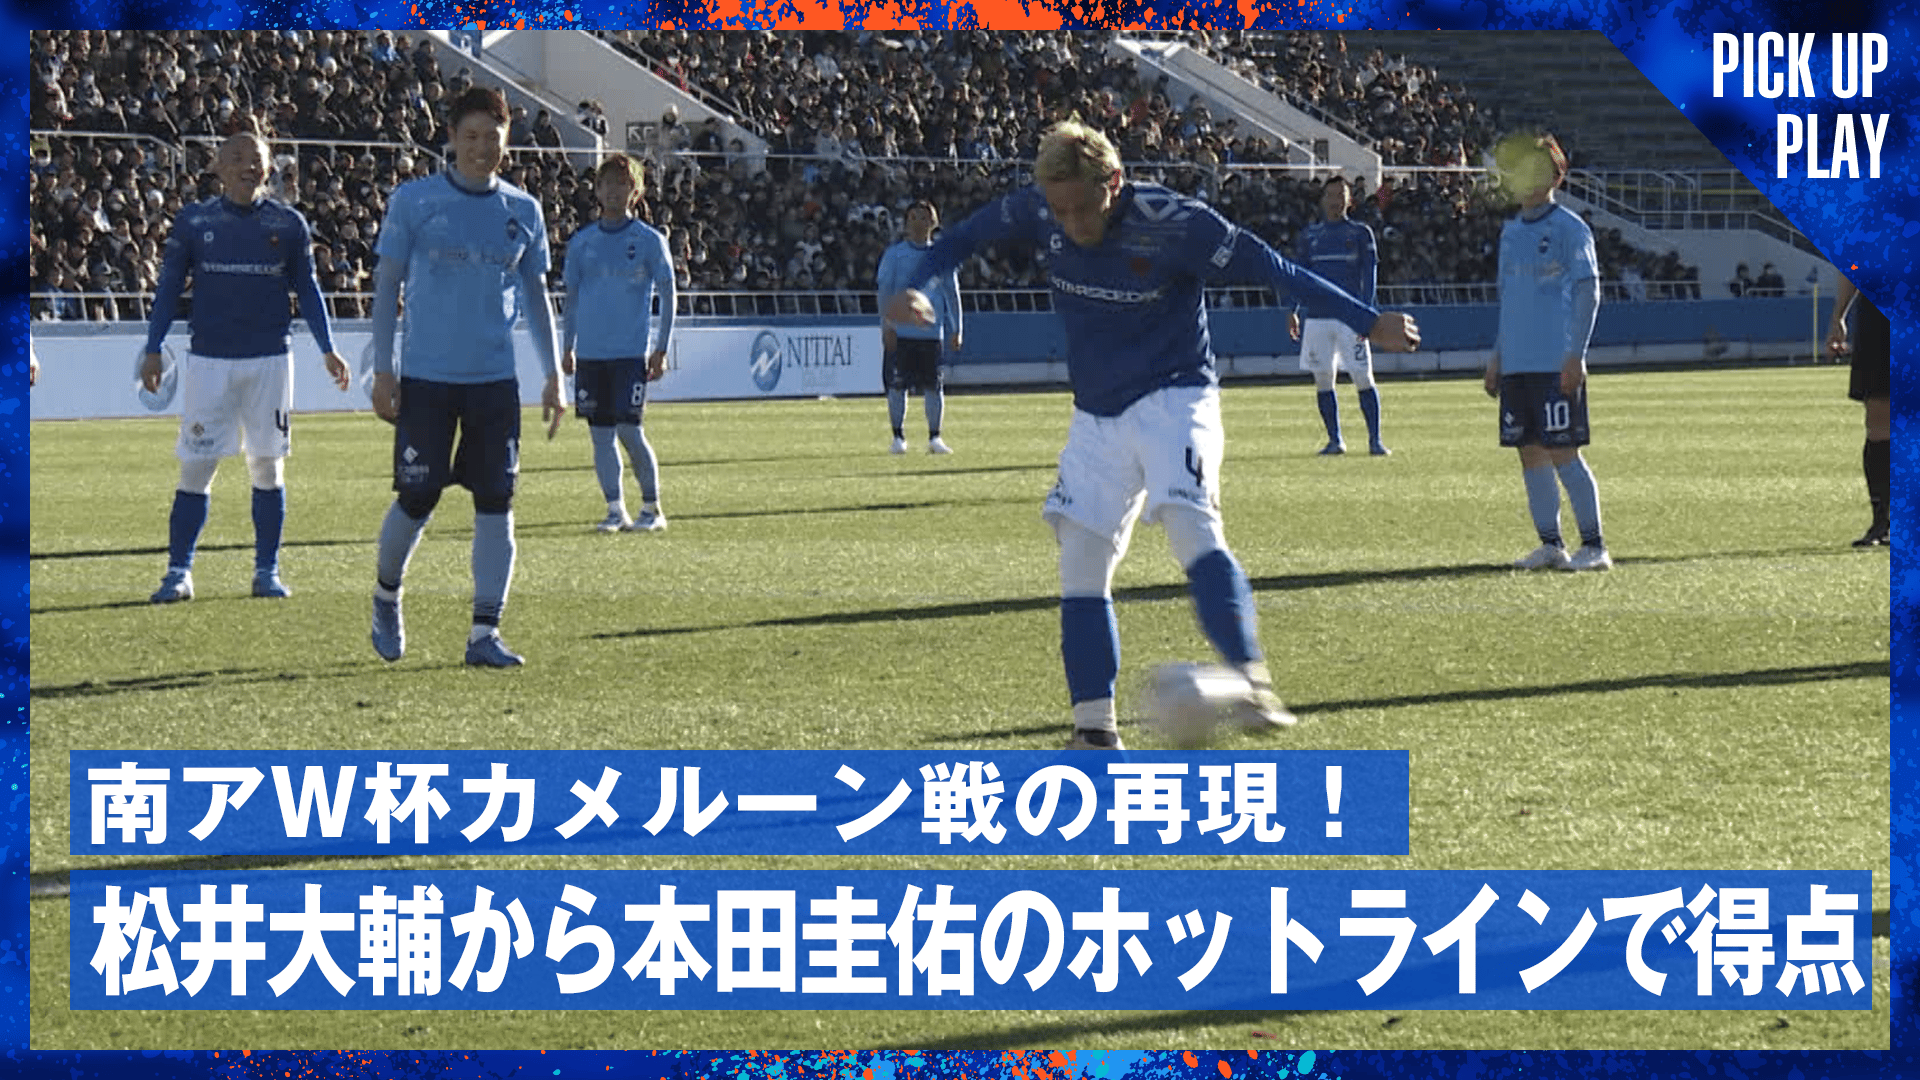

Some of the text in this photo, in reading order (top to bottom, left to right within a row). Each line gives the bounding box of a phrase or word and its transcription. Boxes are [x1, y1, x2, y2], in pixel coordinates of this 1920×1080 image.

[787, 336, 852, 368] NITTAI
[632, 383, 643, 405] 8
[275, 411, 288, 438] 4
[1545, 402, 1570, 432] 10
[1185, 447, 1203, 487] 4
